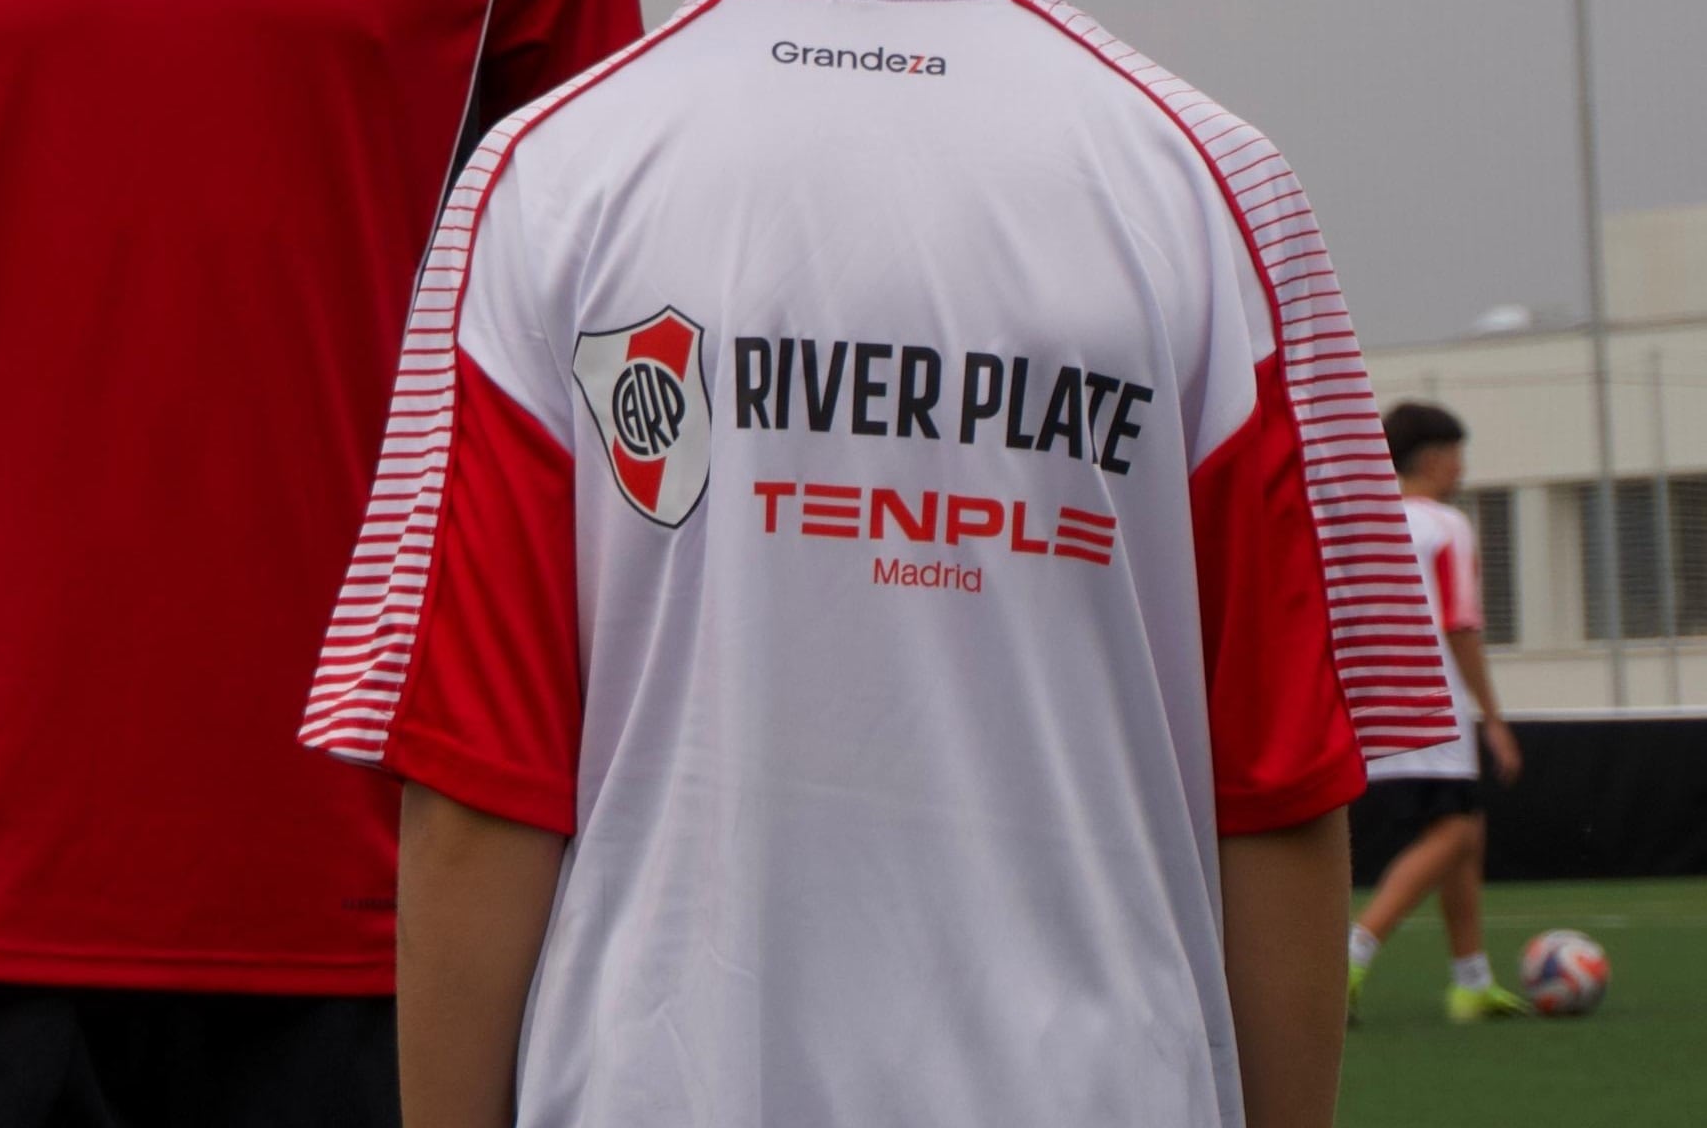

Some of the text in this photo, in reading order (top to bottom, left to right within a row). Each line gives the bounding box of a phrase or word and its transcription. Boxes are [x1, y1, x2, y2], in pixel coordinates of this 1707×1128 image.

[771, 41, 947, 76] Grandeza
[612, 363, 685, 456] CARP
[735, 337, 1154, 475] RIVER PLATE
[753, 481, 1117, 566] TENPLE
[872, 557, 983, 593] Madrid
